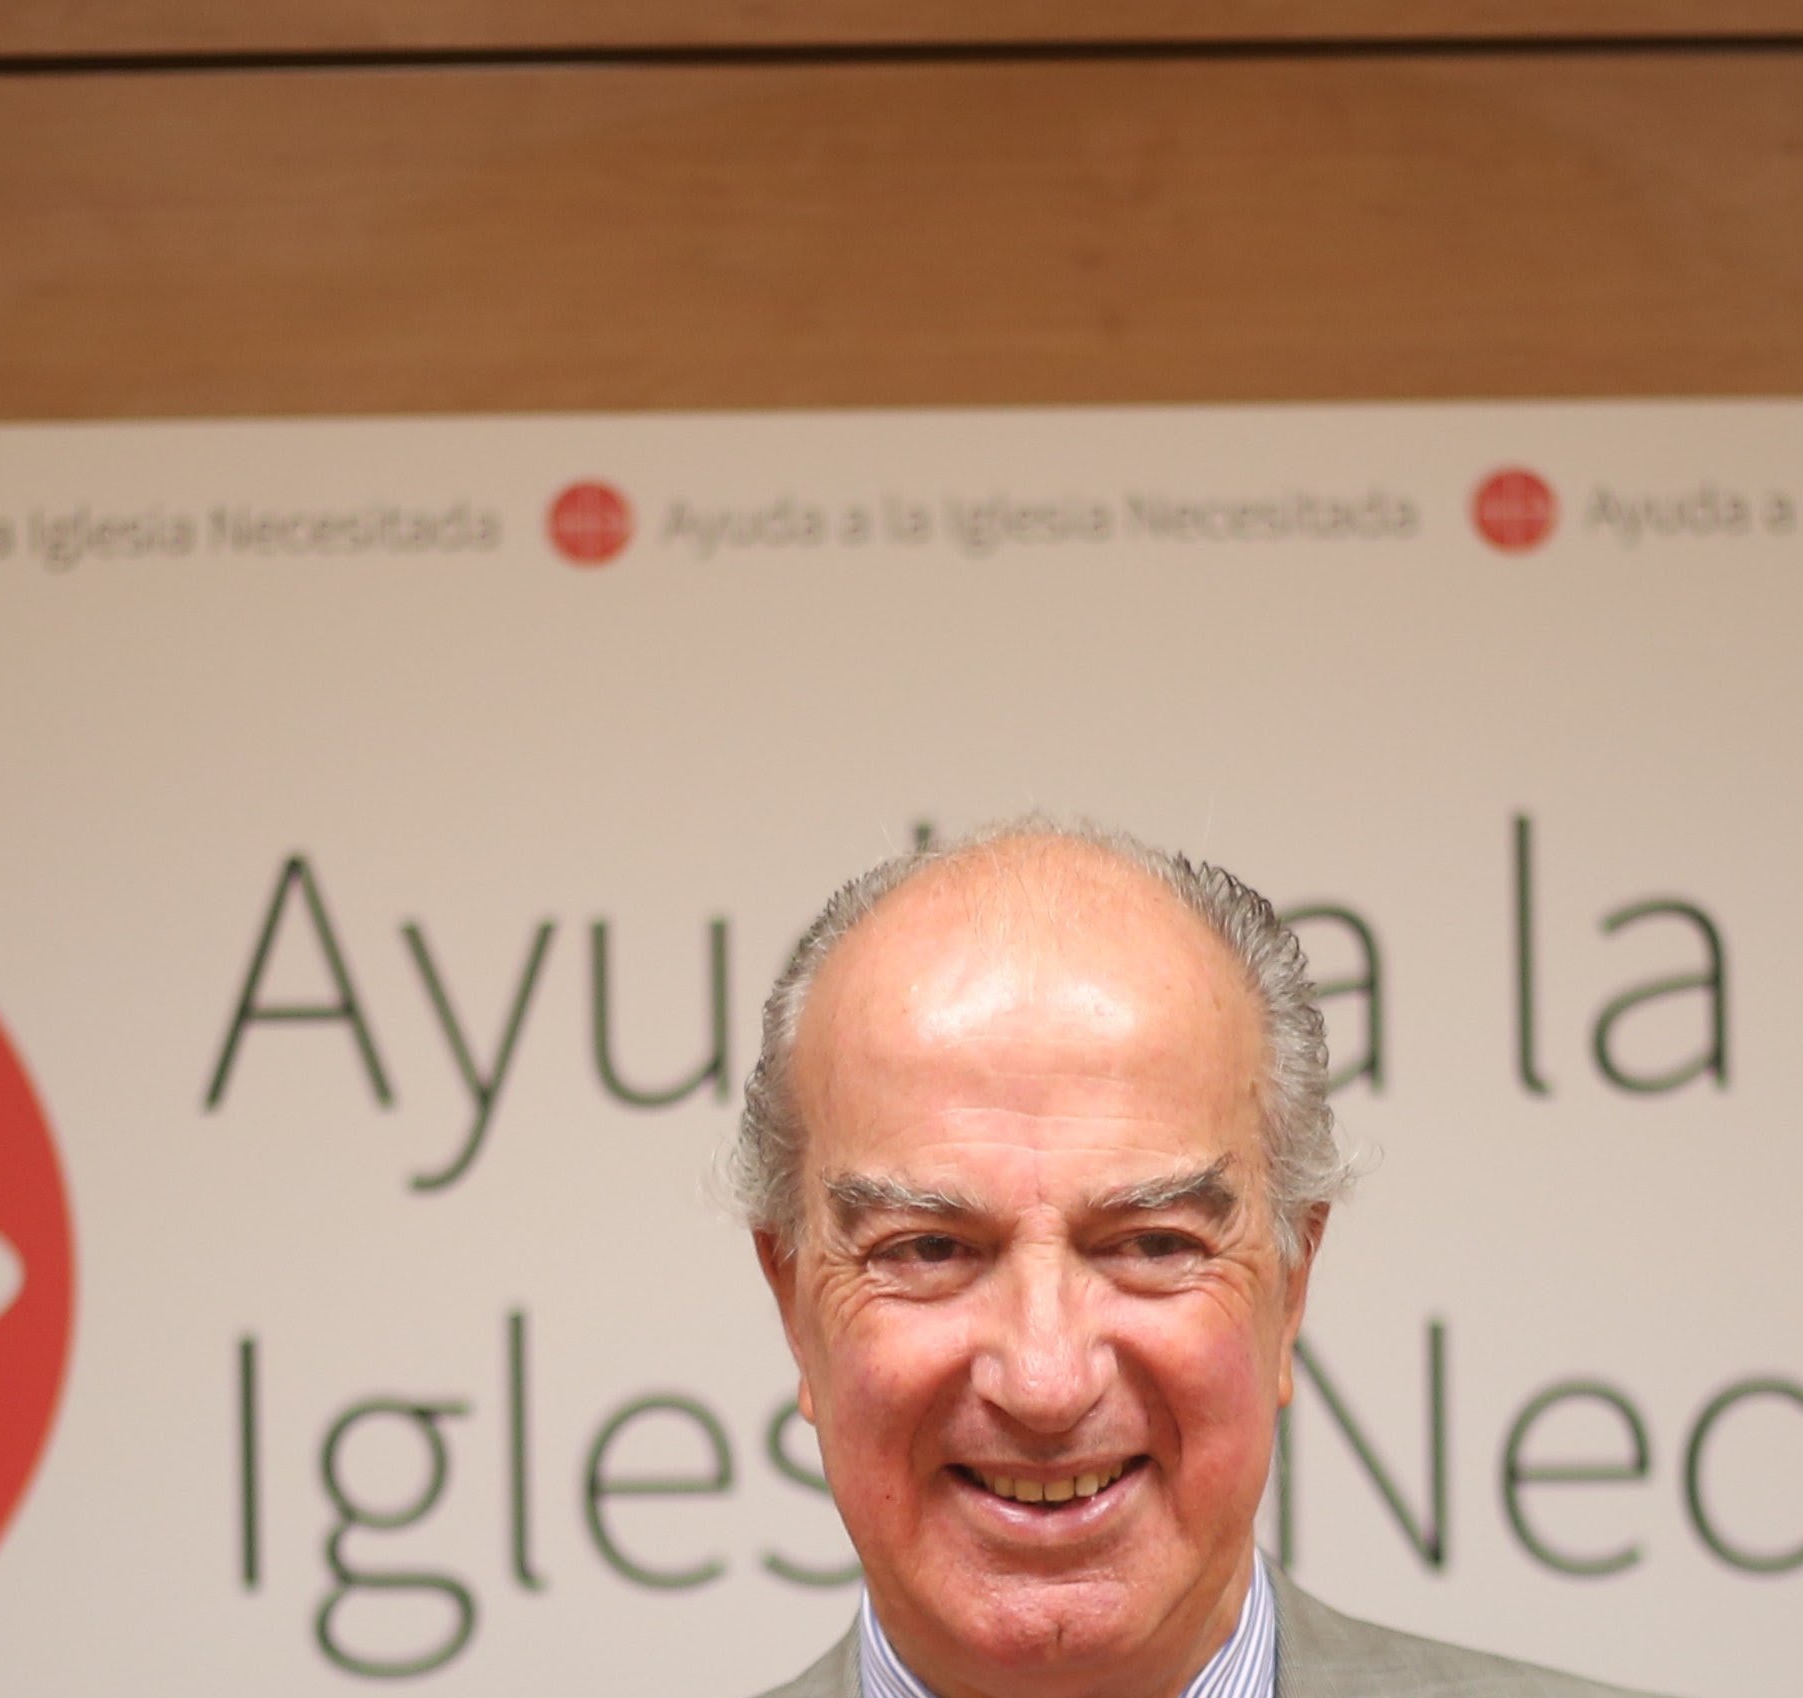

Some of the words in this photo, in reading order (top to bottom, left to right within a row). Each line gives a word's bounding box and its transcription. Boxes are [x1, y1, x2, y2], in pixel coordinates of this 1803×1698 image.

[27, 502, 198, 574] Iglesia
[207, 496, 504, 556] Necesitada
[655, 486, 830, 563] Ayuda
[838, 501, 876, 548] a
[879, 487, 935, 547] la
[941, 487, 1116, 561] Iglesia
[1122, 483, 1422, 542] Necesitada
[1583, 476, 1754, 551] Ayuda
[1760, 488, 1798, 536] a
[205, 818, 936, 1192] Ayu
[1510, 810, 1732, 1097] la
[234, 1305, 860, 1680] Igles
